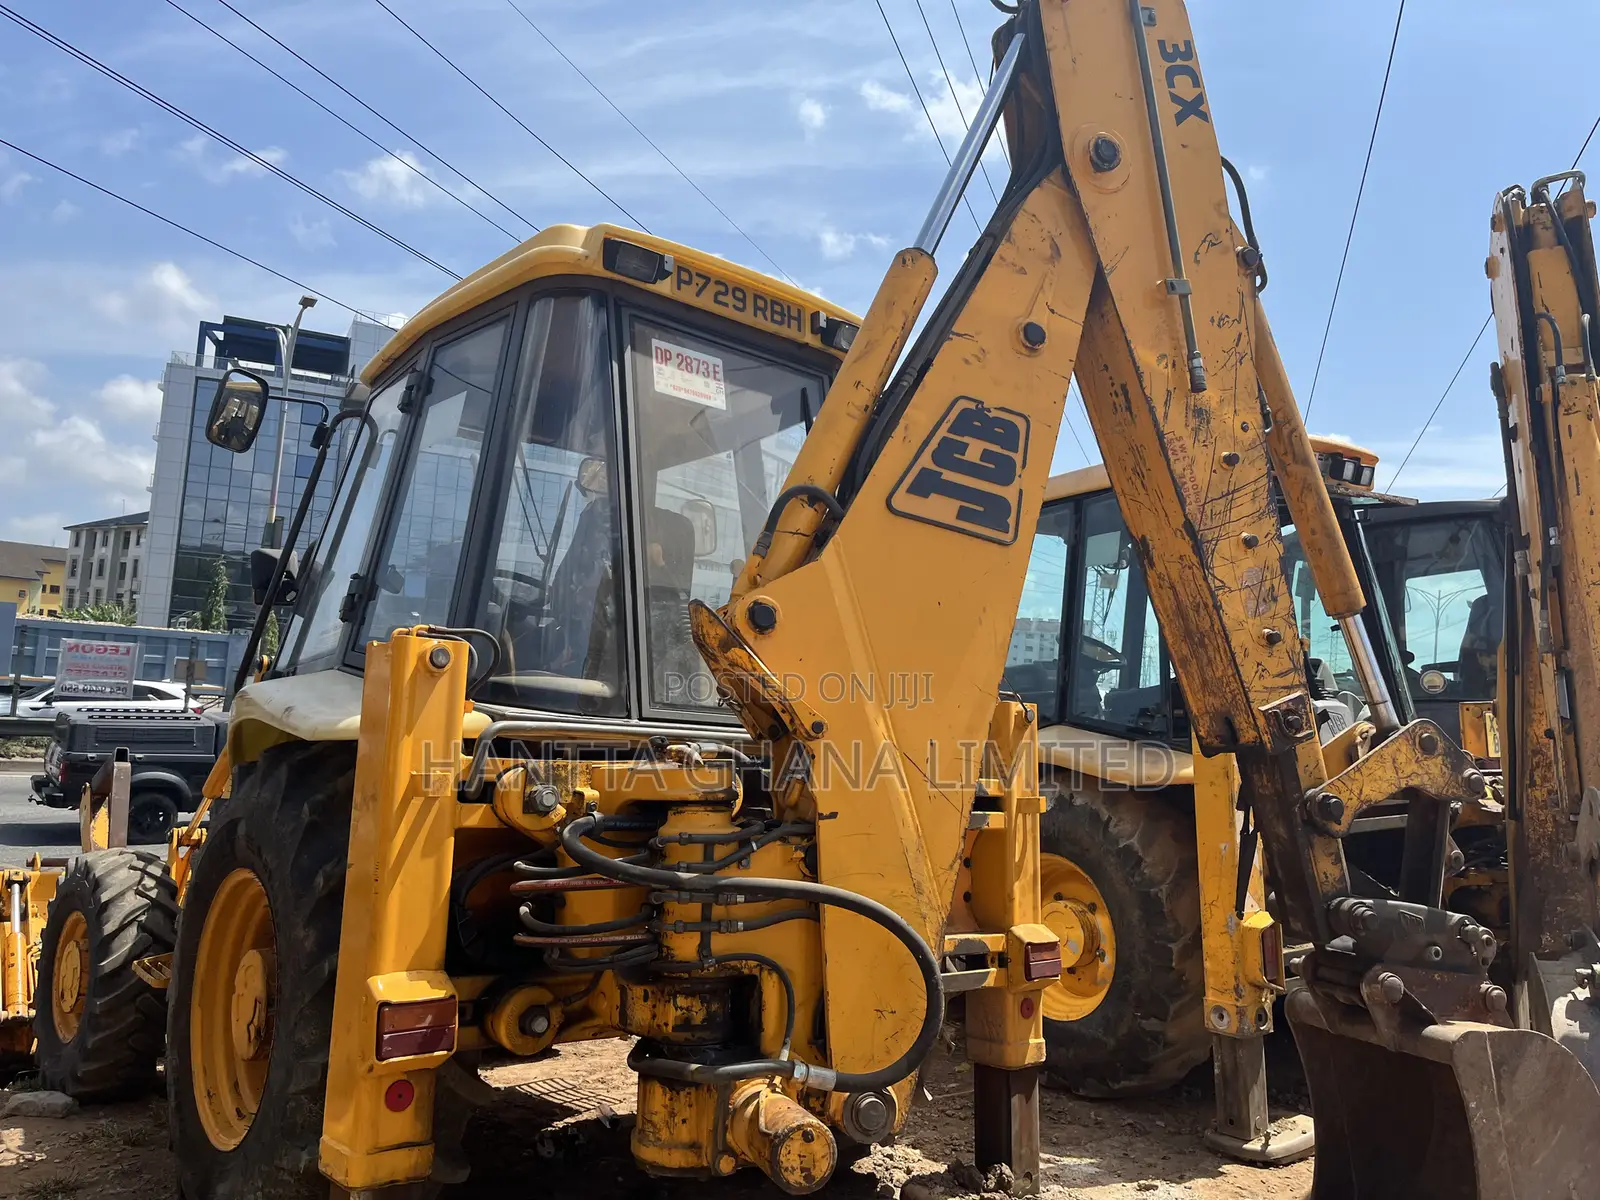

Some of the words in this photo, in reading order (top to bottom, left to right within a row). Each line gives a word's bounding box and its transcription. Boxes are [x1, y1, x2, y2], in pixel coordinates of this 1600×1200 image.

[1157, 39, 1210, 127] 3CX
[676, 264, 747, 313] P729
[753, 293, 802, 333] RBH
[655, 346, 673, 366] DP
[676, 353, 710, 379] 2873
[712, 364, 721, 382] E
[905, 407, 1021, 534] JCB
